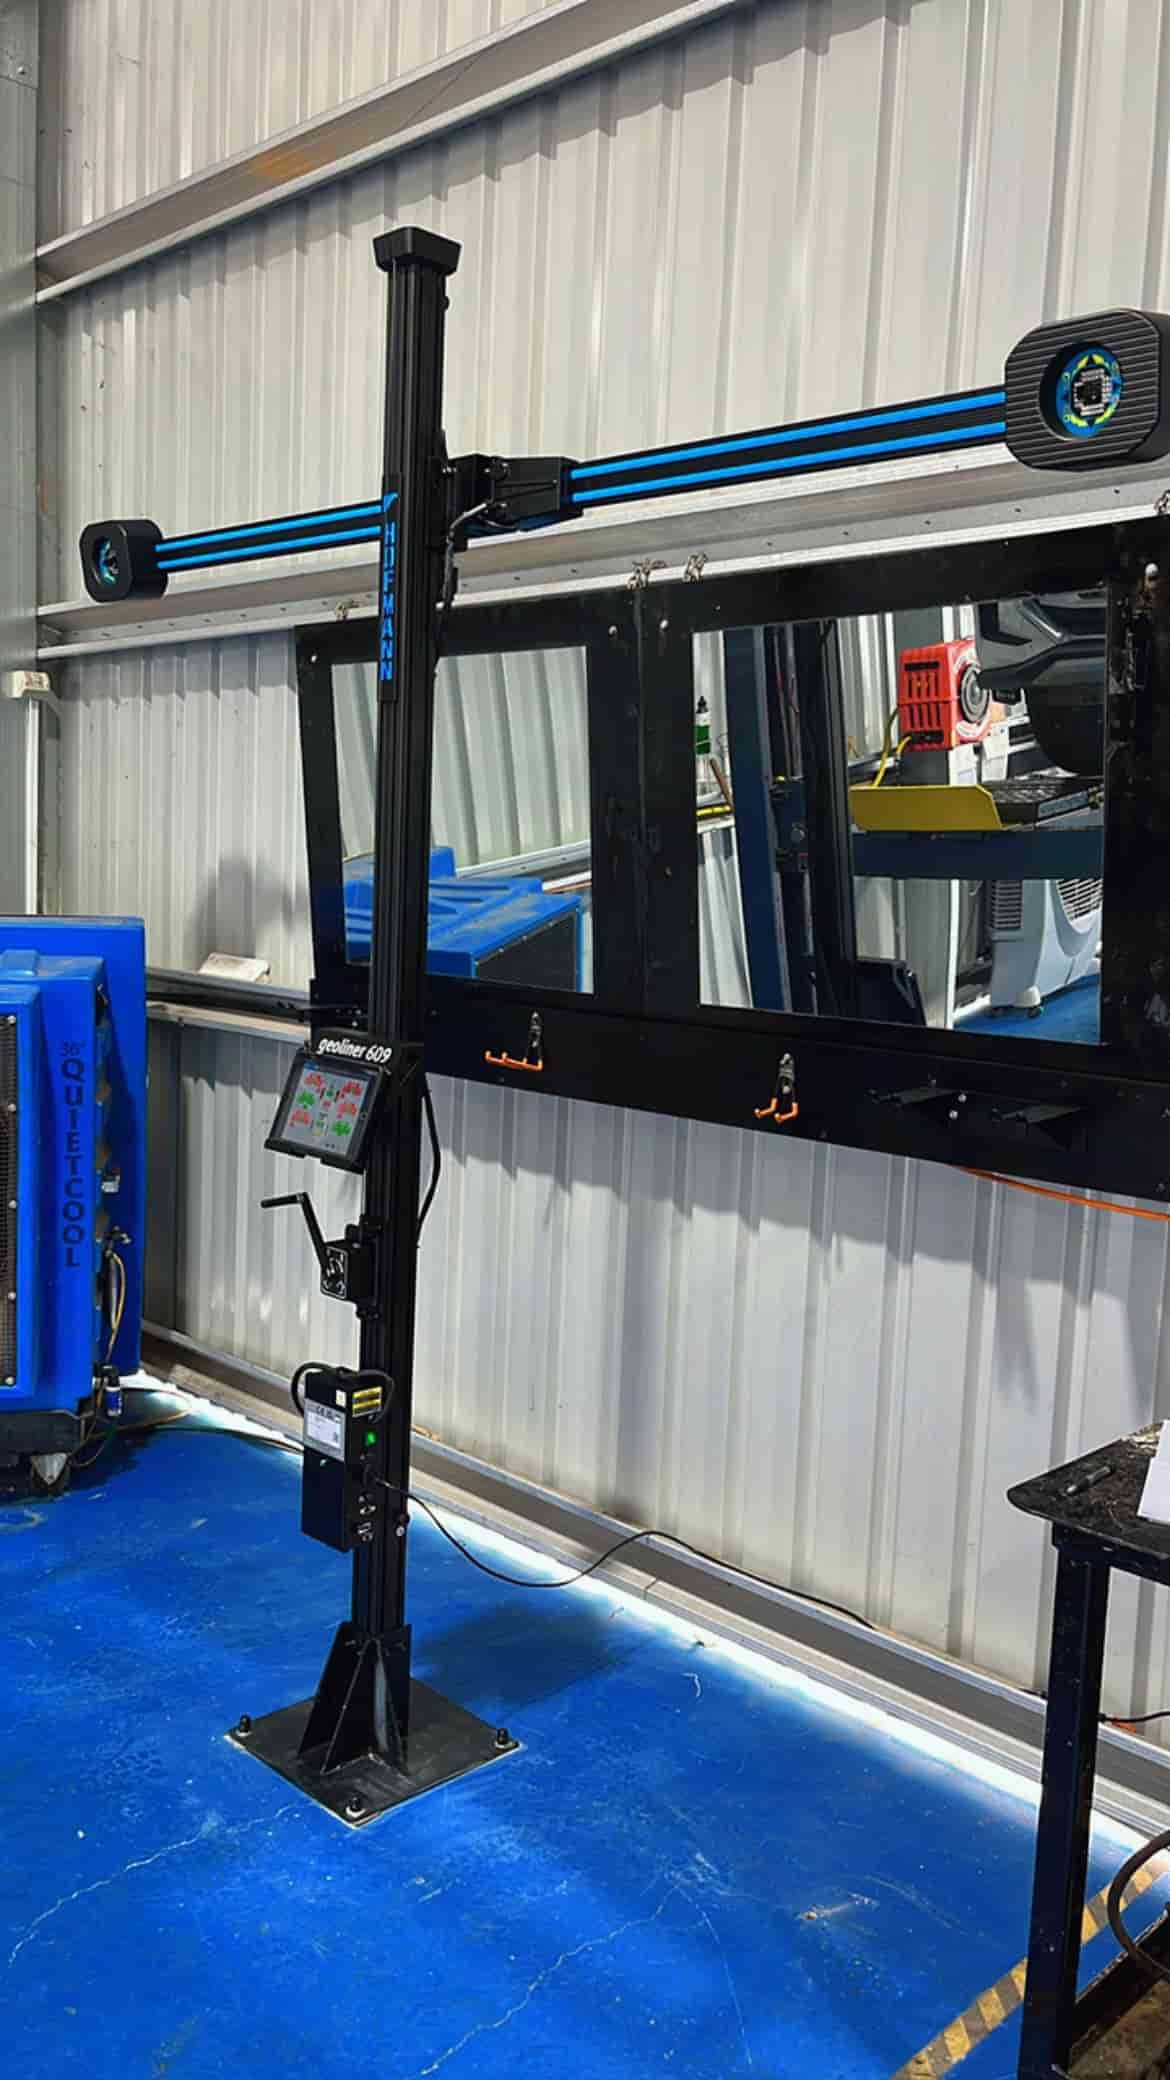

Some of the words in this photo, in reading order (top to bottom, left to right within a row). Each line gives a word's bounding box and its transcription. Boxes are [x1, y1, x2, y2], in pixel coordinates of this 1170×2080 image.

[381, 522, 396, 680] HOFMANN
[316, 1038, 367, 1058] geoliner
[365, 1045, 393, 1063] 609
[60, 1058, 85, 1268] QUIETCOOL
